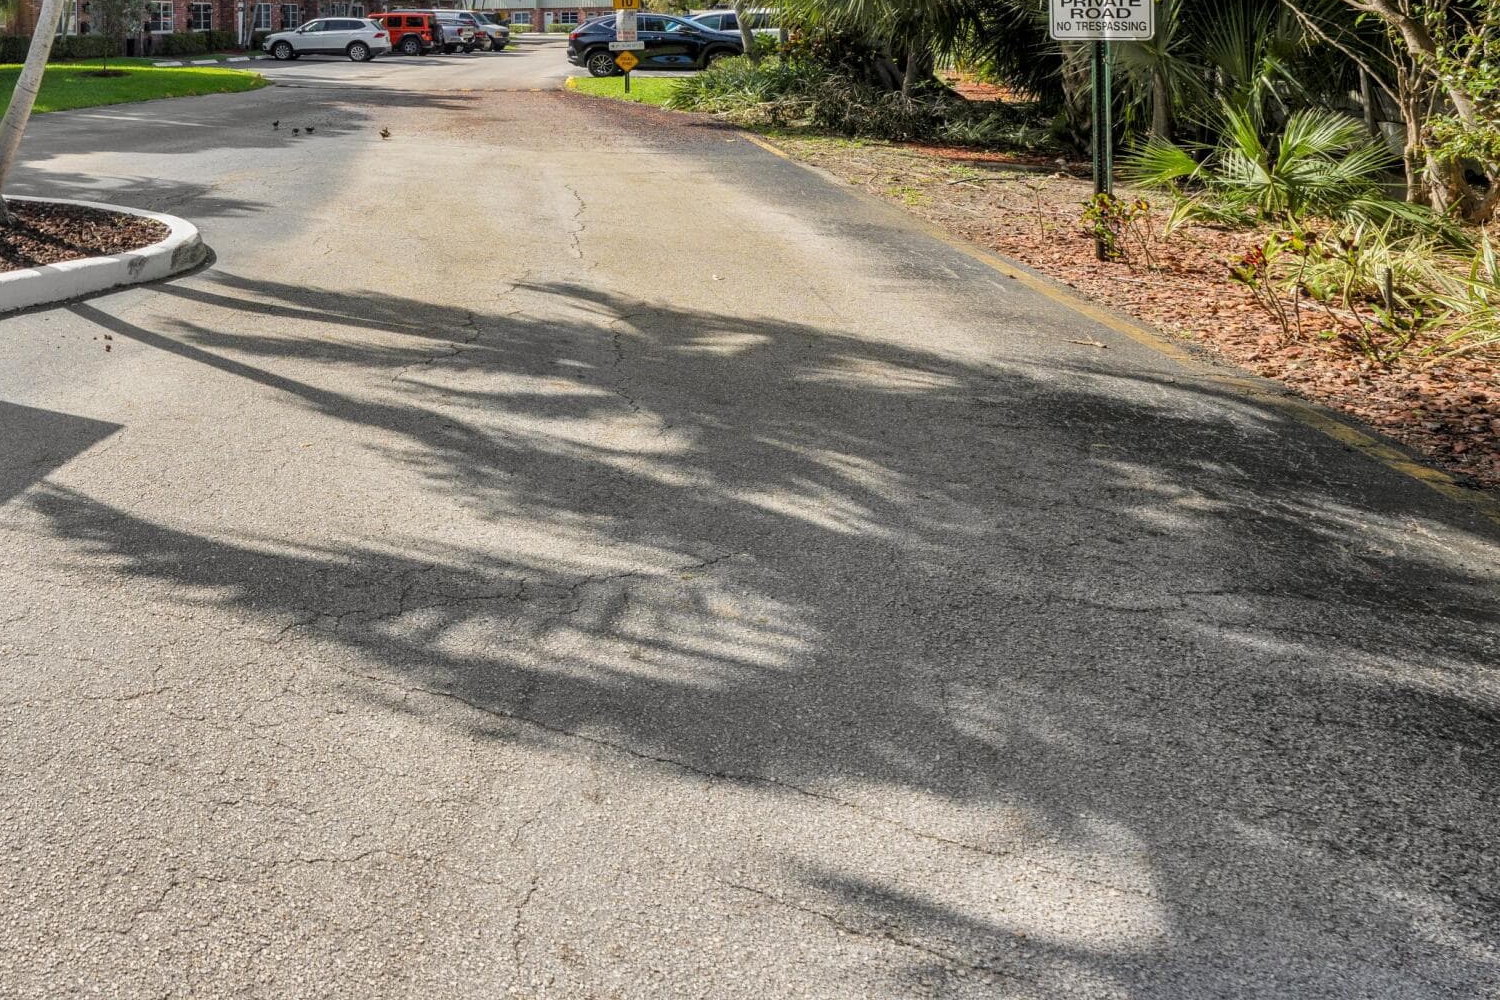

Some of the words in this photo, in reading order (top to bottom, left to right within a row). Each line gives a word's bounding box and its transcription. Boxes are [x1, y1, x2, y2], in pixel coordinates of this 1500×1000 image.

[1070, 8, 1131, 19] ROAD
[1056, 21, 1071, 31] NO
[1076, 21, 1147, 31] TRESPASSING
